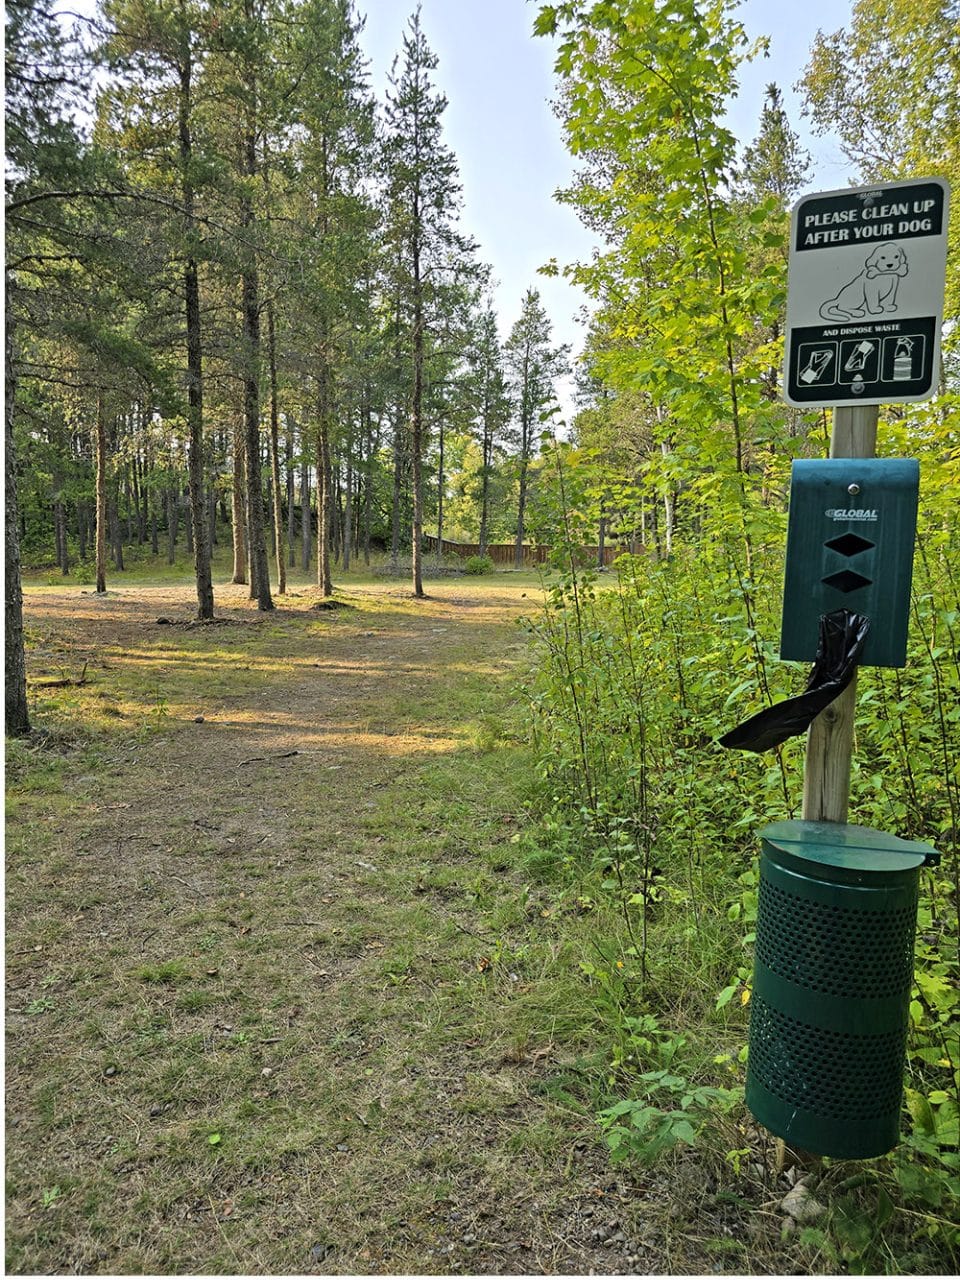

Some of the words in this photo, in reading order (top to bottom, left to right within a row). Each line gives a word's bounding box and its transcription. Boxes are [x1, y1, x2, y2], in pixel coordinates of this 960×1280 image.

[805, 209, 858, 228] PLEASE
[861, 202, 909, 220] CLEAN
[913, 199, 935, 213] UP
[804, 228, 849, 245] AFTER
[853, 223, 894, 239] YOUR
[898, 219, 932, 234] DOG
[822, 328, 839, 337] AND
[840, 325, 874, 335] DISPOSE
[874, 323, 901, 332] WASTE
[833, 509, 878, 518] GLOBAL
